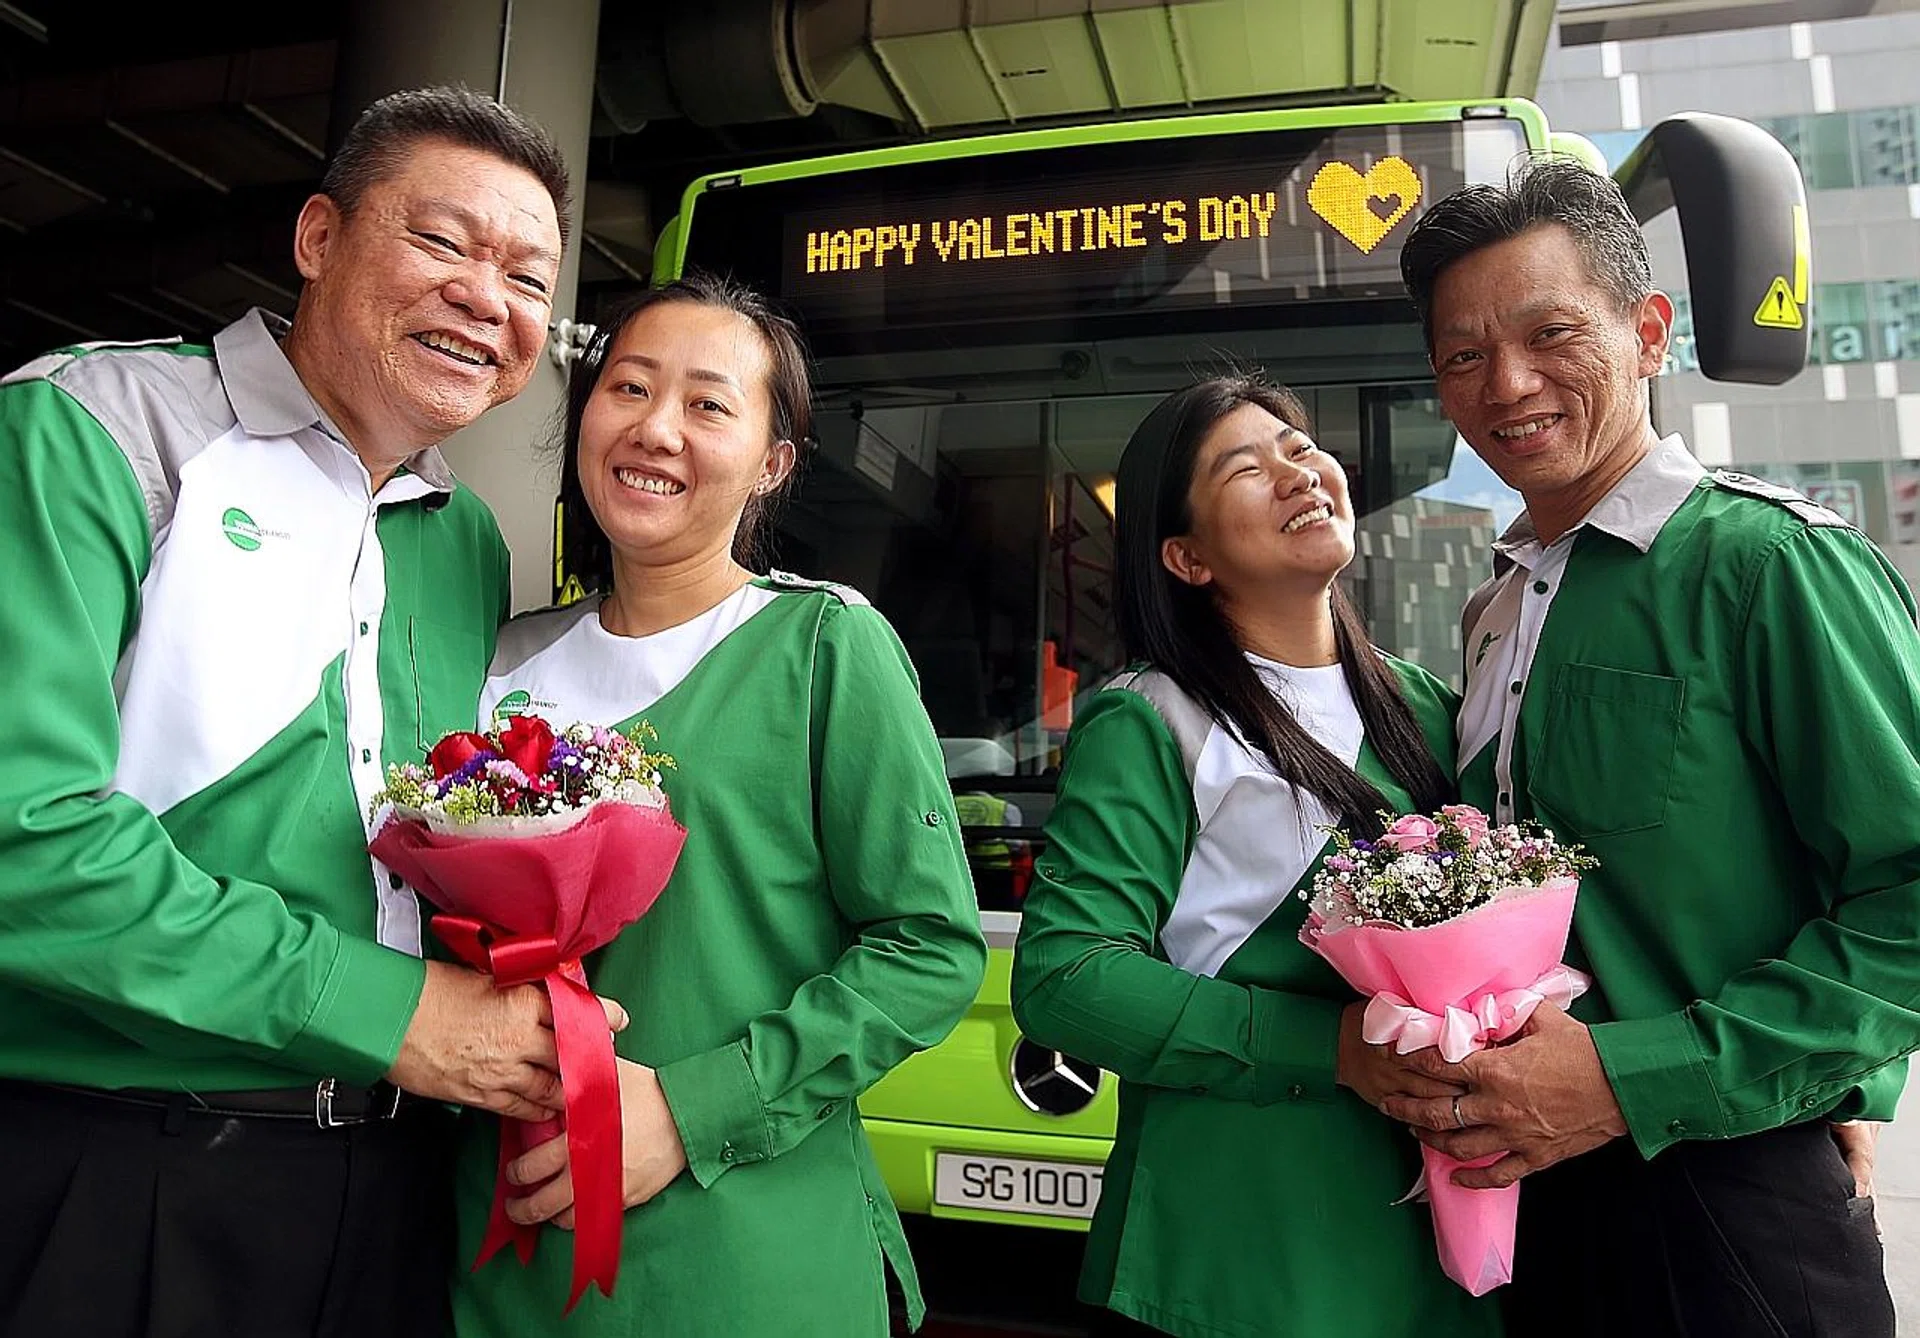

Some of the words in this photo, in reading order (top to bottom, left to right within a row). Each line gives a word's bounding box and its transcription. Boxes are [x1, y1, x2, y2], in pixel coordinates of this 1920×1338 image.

[806, 223, 920, 274] HAPPY
[931, 200, 1186, 262] VALENTINE'S
[1199, 191, 1276, 244] DAY
